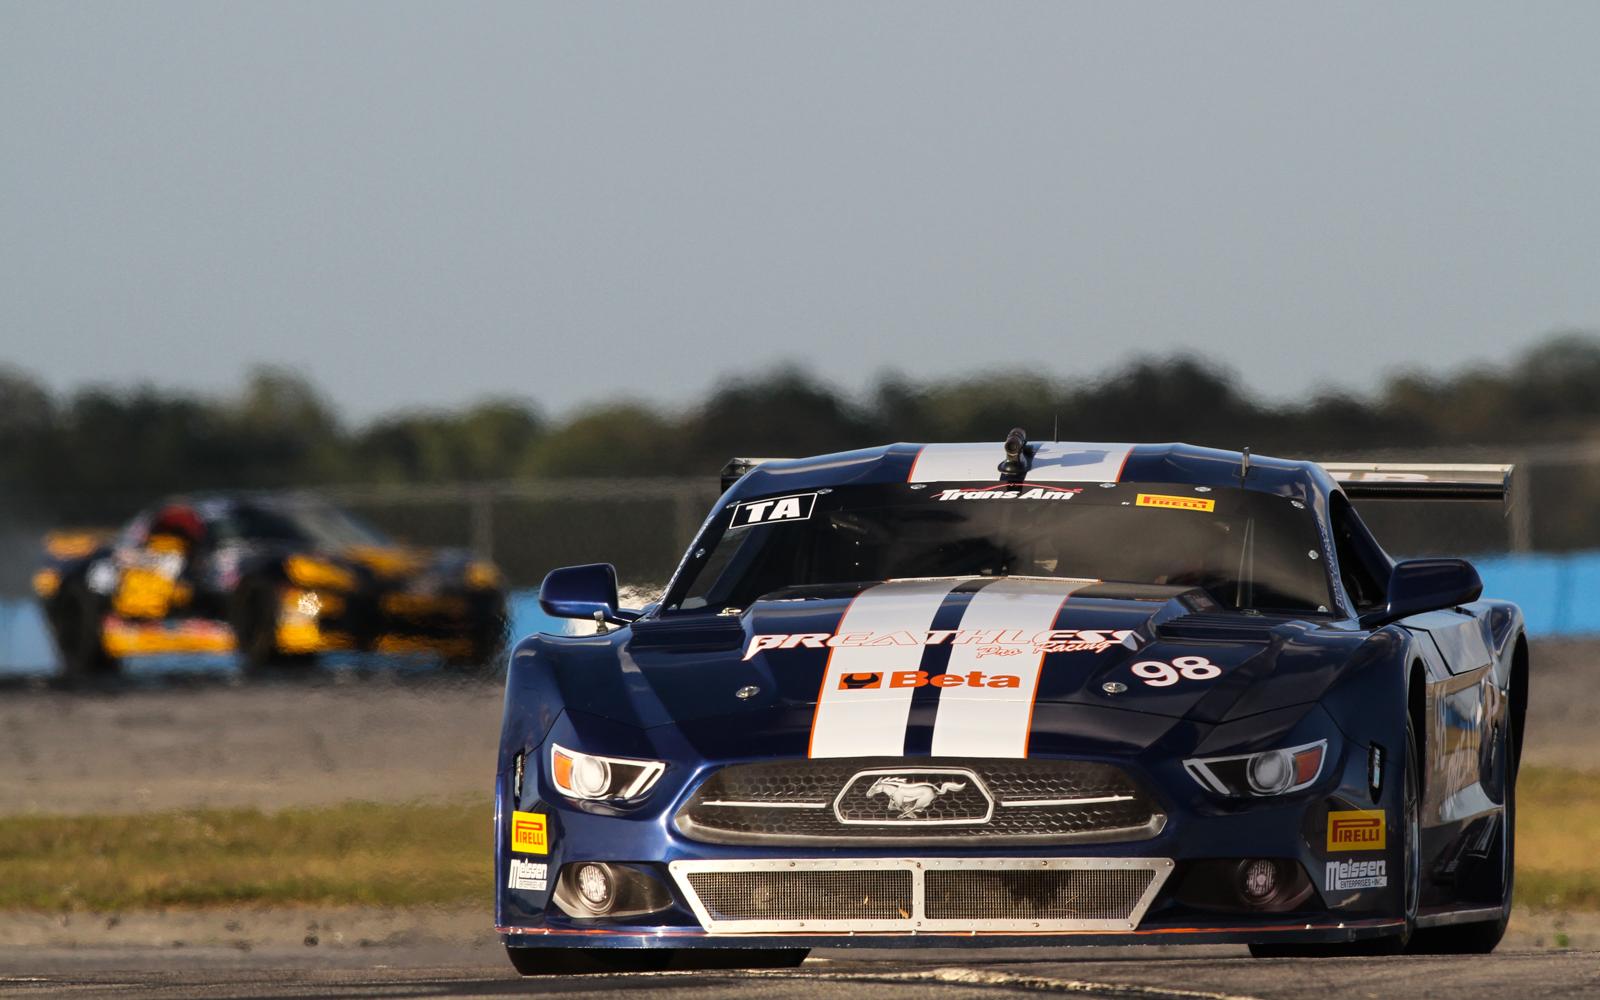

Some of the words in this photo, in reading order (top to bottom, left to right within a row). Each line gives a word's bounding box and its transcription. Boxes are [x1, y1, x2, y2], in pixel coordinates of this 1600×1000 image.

[938, 488, 1019, 501] Trans
[1017, 487, 1075, 500] Am
[746, 497, 801, 523] TA
[742, 628, 1142, 661] BREATHLESS
[1032, 640, 1112, 655] Racing
[888, 670, 1021, 690] Beta
[1131, 656, 1222, 687] 98
[515, 819, 544, 846] PIRELLI
[1331, 817, 1381, 844] PIRELLI
[1325, 858, 1387, 891] Meissen
